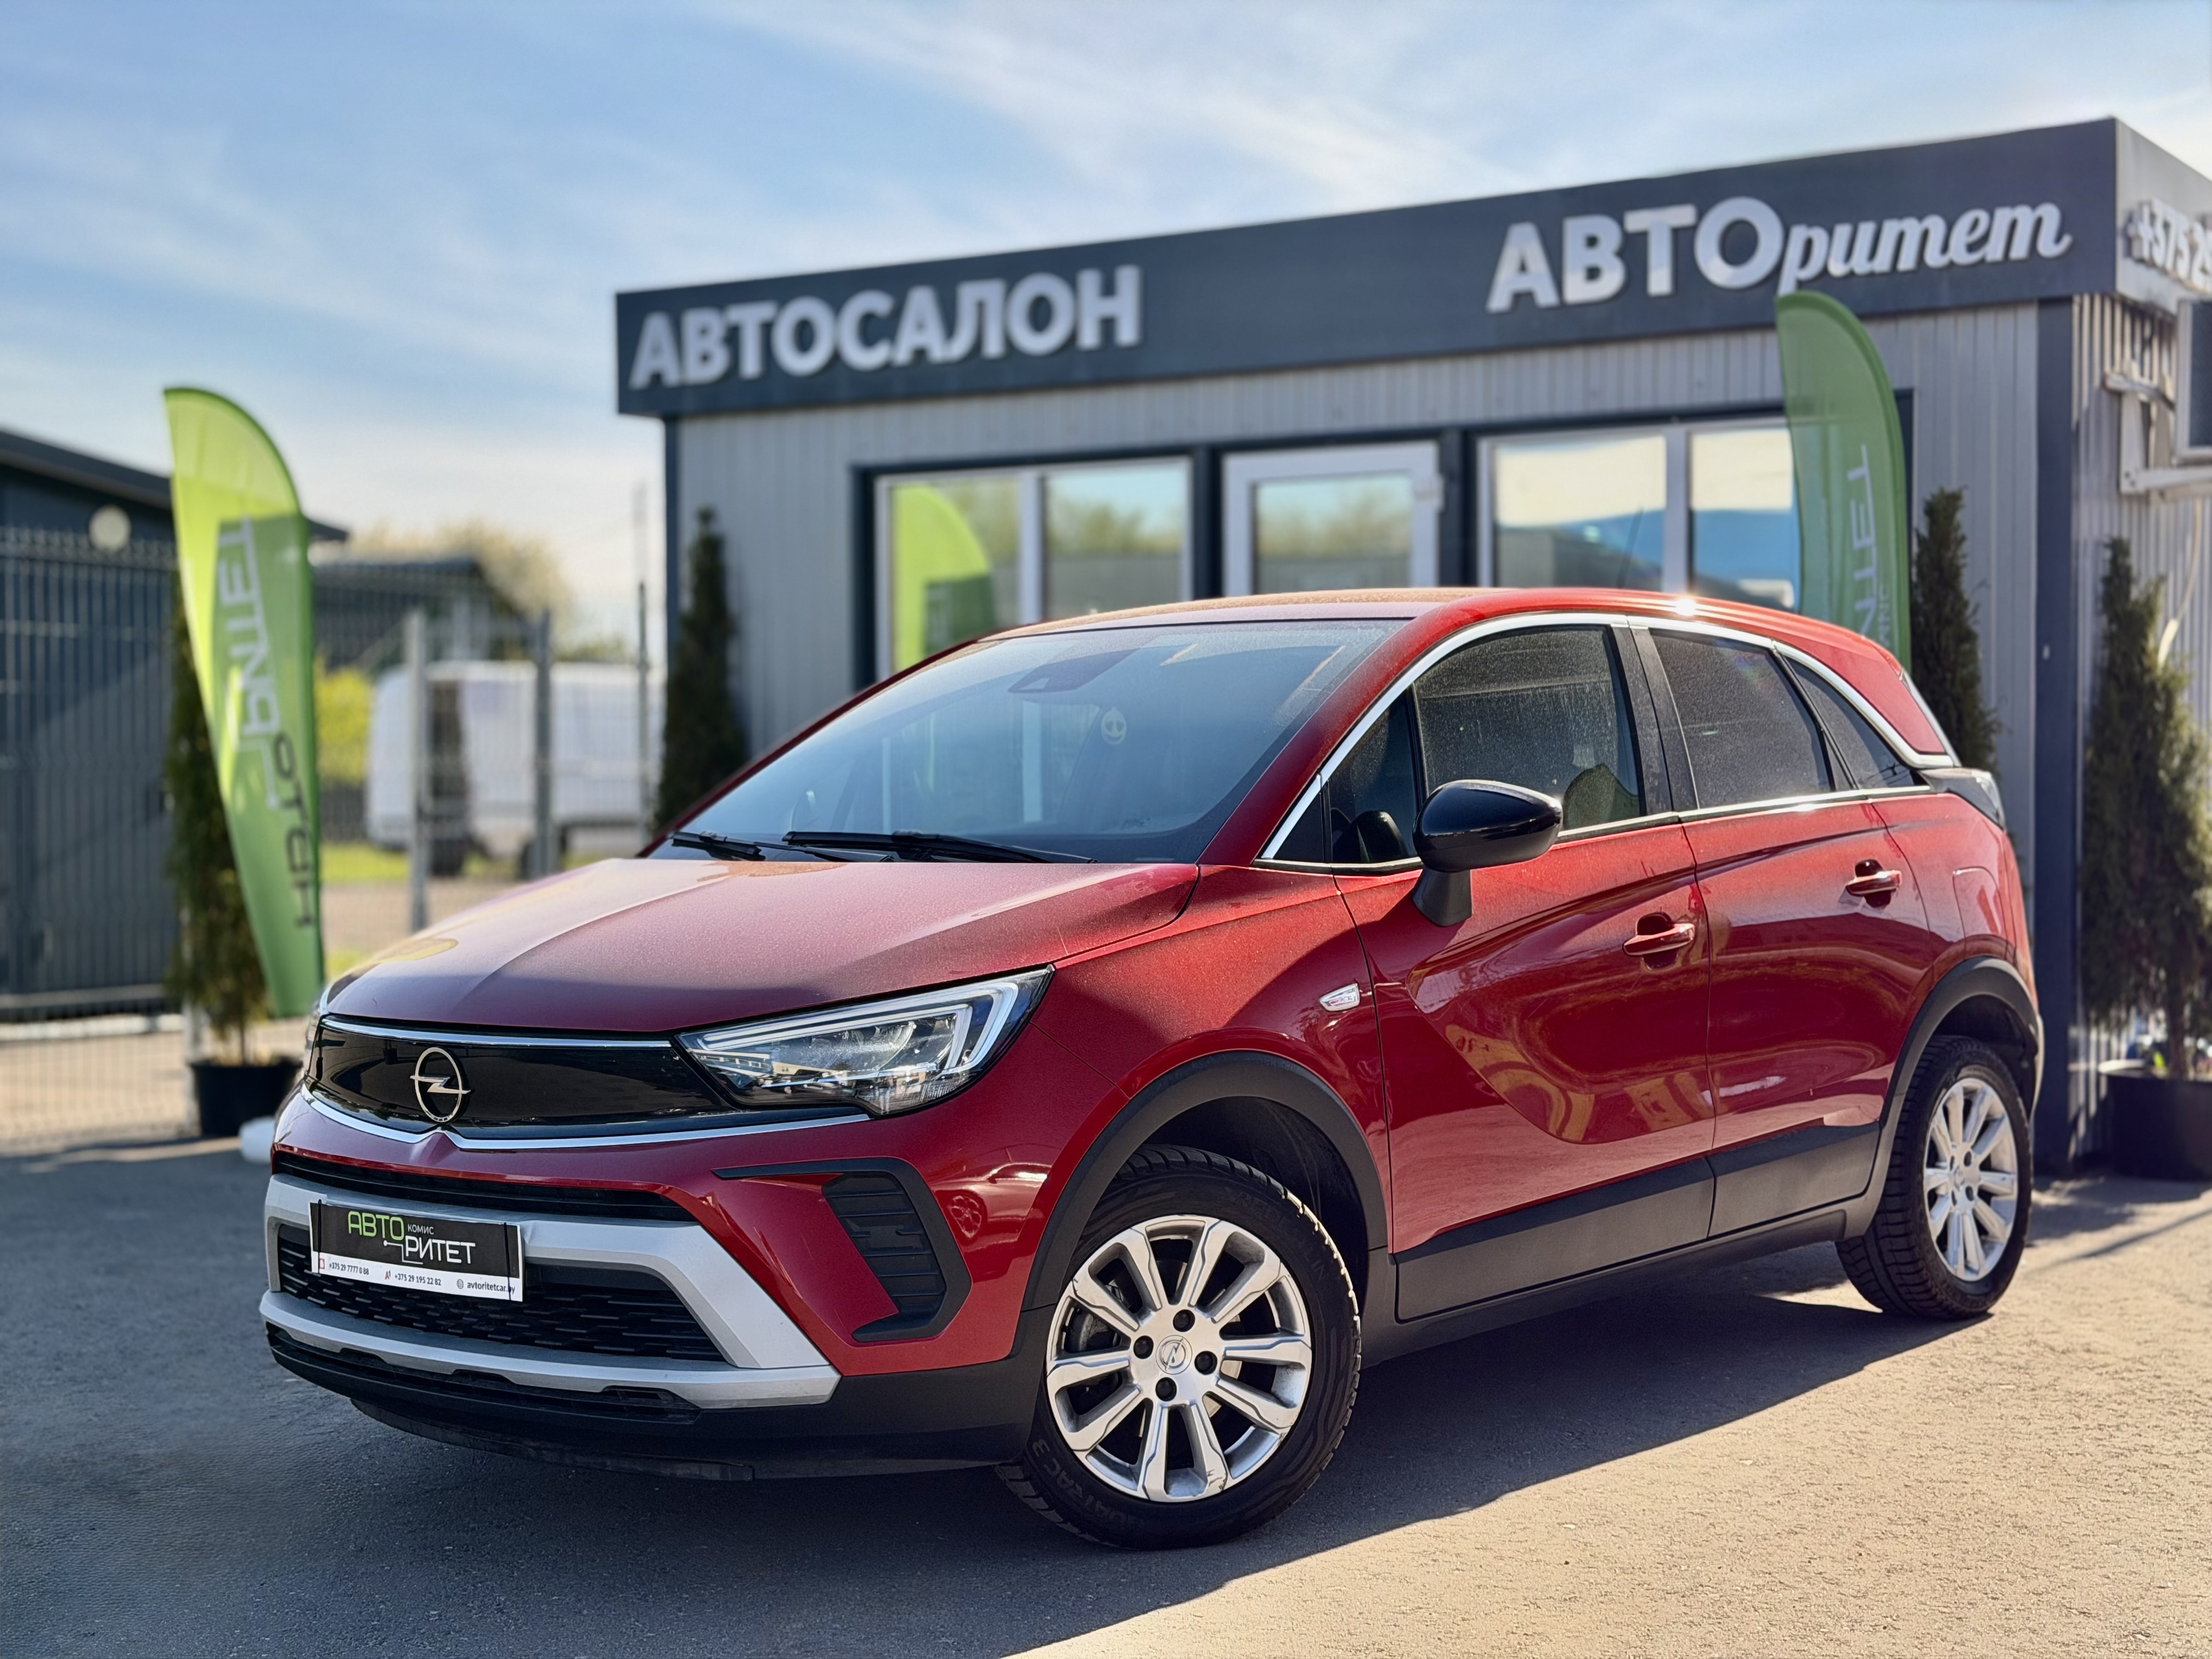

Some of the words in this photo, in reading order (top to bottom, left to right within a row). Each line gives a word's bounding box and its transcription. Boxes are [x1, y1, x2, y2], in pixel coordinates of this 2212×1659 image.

[1486, 196, 2073, 313] АВТОритет
[628, 264, 1141, 390] АВТОСАЛОН
[348, 1210, 404, 1240] АВТО
[405, 1235, 476, 1264] РИТЕТ
[394, 1273, 407, 1281] +375
[416, 1276, 426, 1284] 195
[427, 1277, 433, 1285] 22
